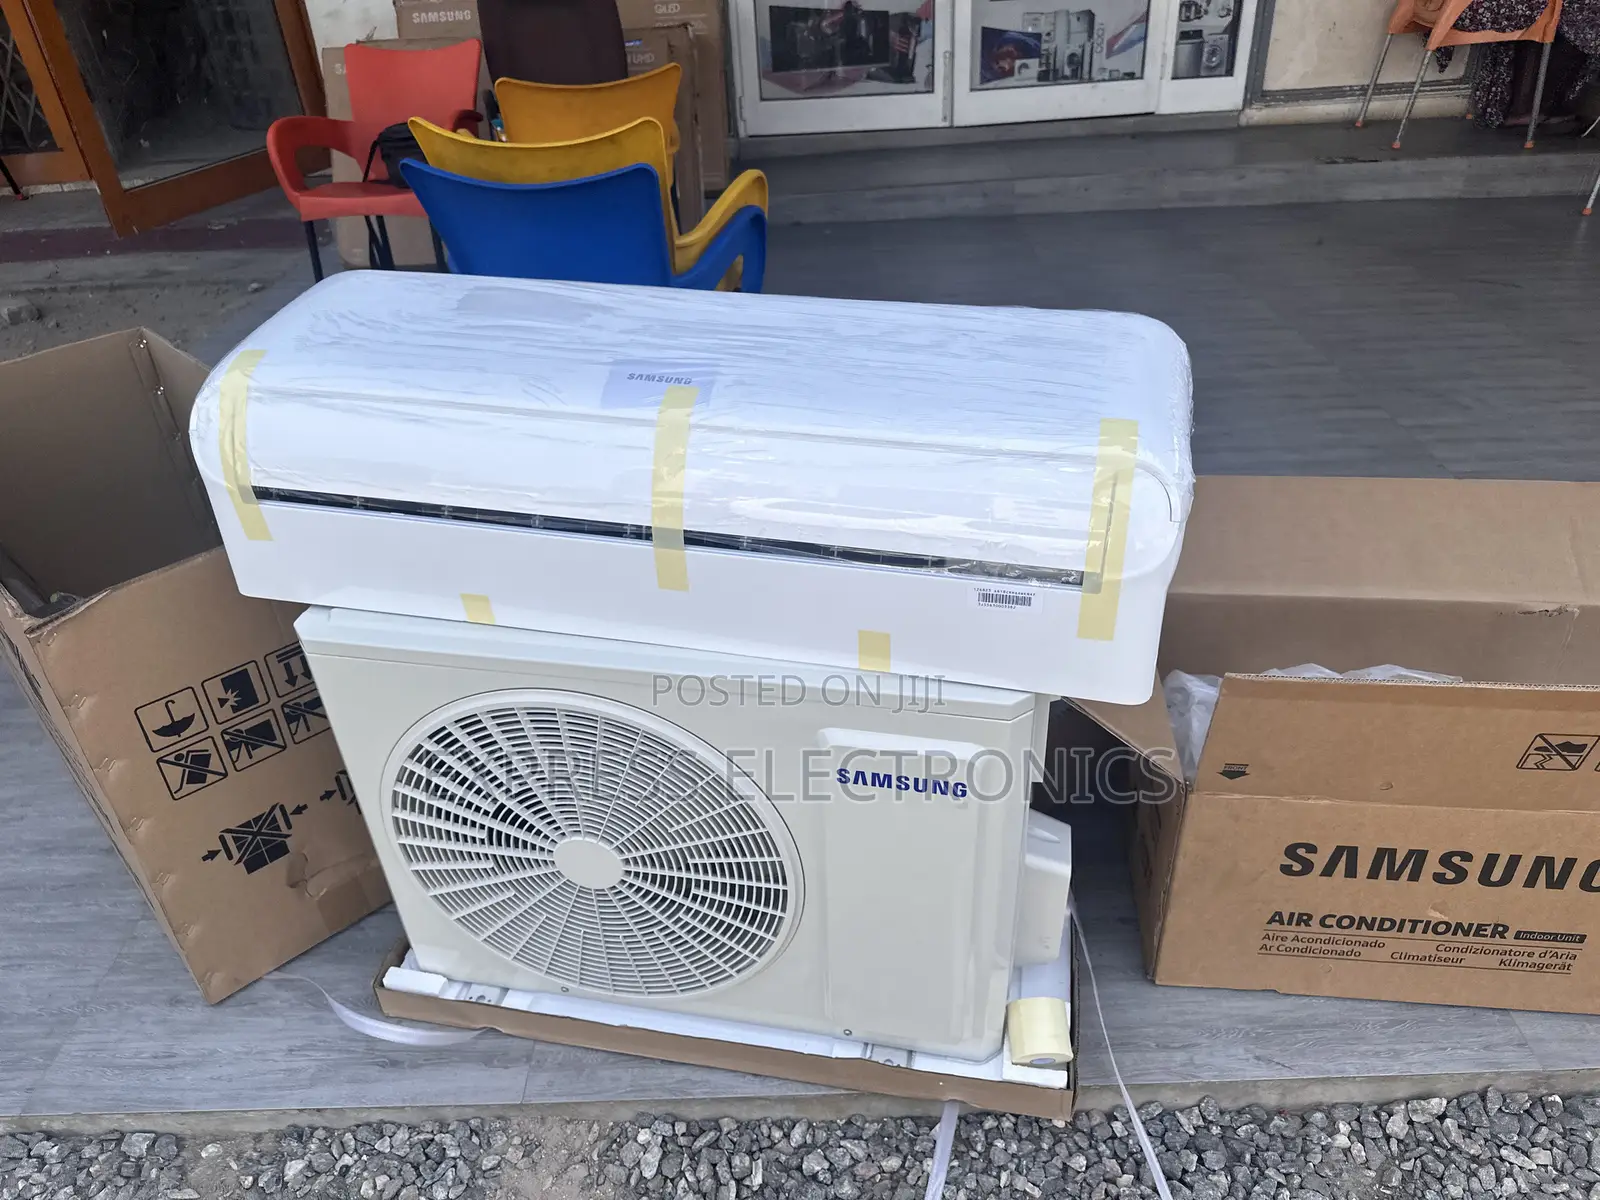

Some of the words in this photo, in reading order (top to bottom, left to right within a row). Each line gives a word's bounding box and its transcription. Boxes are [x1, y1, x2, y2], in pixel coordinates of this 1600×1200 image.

[412, 10, 471, 24] SAMSUNG
[627, 372, 693, 385] SAMSUNG
[836, 768, 967, 798] SAMSUNG
[1266, 911, 1313, 927] AIR
[1318, 913, 1510, 940] CONDITIONER
[1261, 933, 1288, 943] Aire
[1290, 934, 1386, 949] Acondicionado
[1519, 931, 1555, 941] Indoor
[1556, 934, 1580, 943] Unit
[1259, 943, 1276, 952] Ar
[1276, 943, 1362, 958] Condicionado
[1435, 943, 1535, 959] Condizionatore
[1538, 949, 1578, 961] d'Aria
[1390, 951, 1466, 965] Climatiseur
[1498, 958, 1573, 971] Klimagerät
